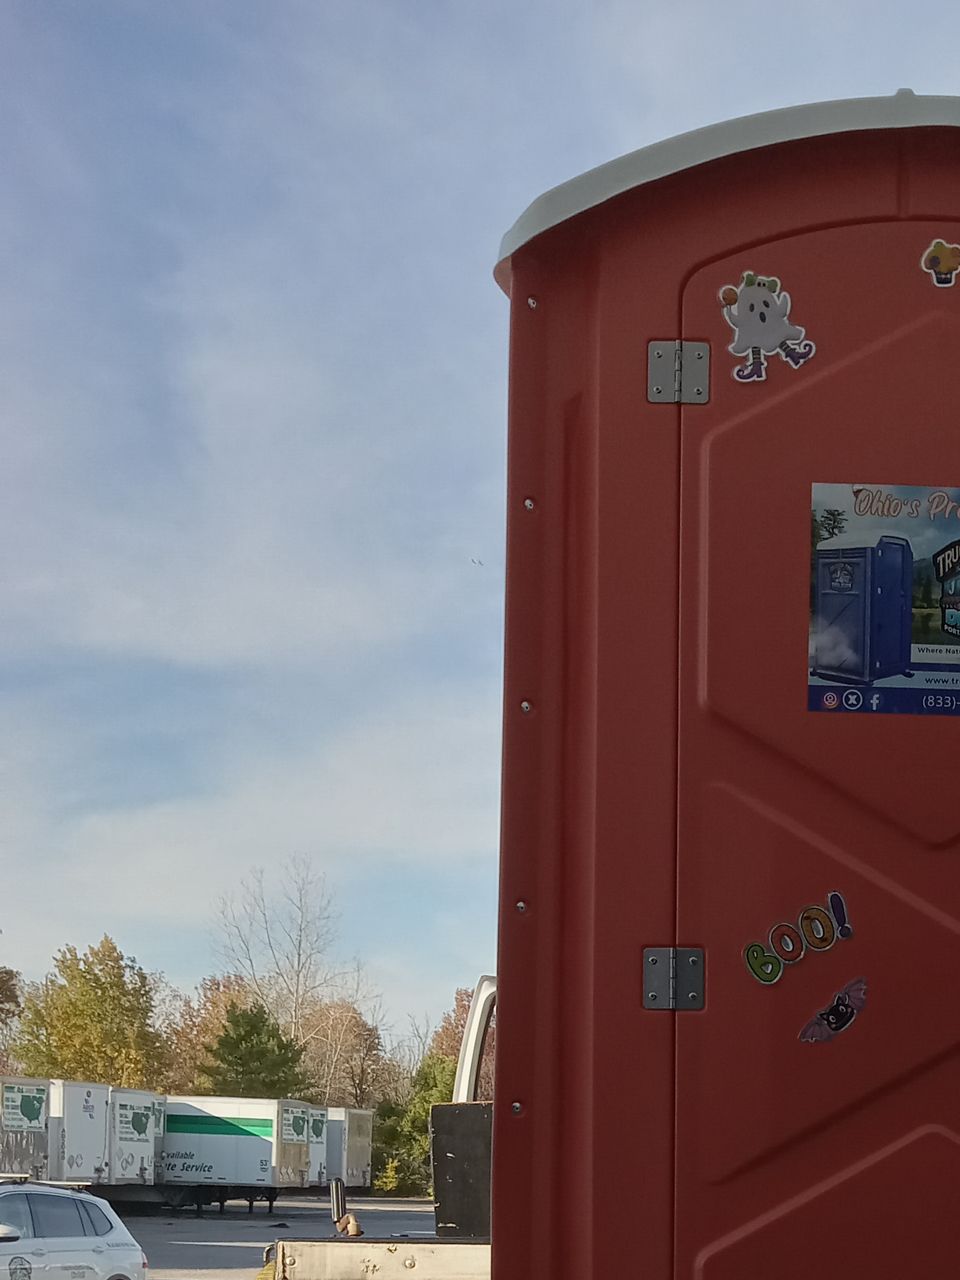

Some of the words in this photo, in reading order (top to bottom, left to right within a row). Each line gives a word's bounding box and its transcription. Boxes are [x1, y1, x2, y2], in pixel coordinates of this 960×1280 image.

[854, 488, 920, 518] Ohio's
[744, 890, 852, 984] BOO!
[164, 1151, 195, 1160] vailable
[180, 1162, 213, 1172] Service
